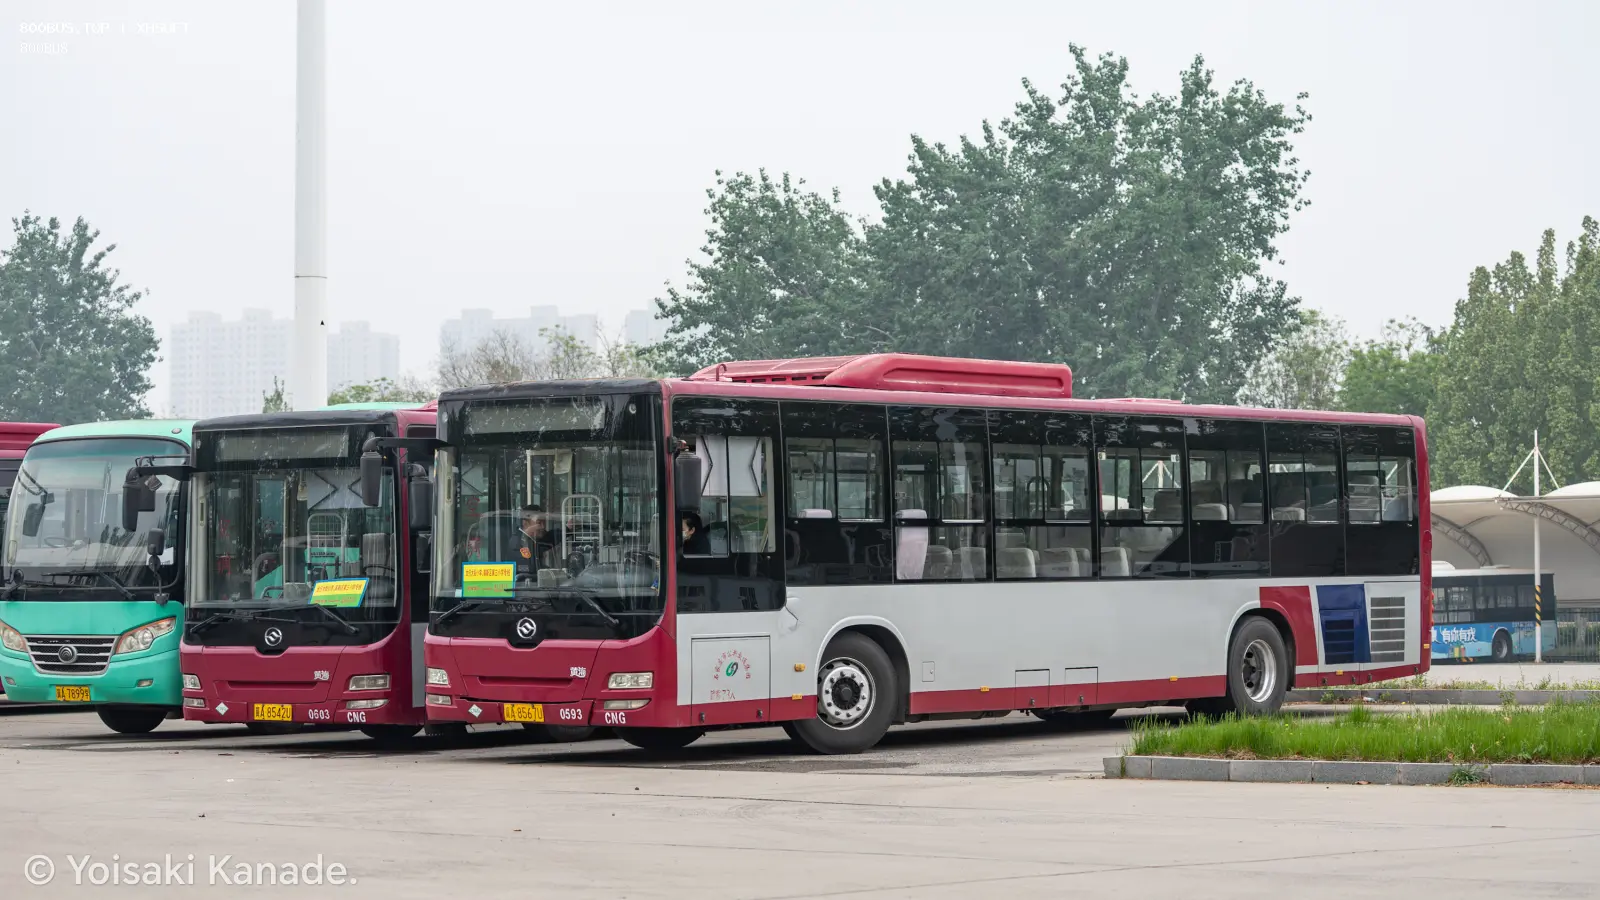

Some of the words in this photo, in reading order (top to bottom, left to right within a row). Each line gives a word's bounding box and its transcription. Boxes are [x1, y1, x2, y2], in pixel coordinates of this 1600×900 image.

[308, 708, 331, 720] 0603
[347, 711, 367, 723] CNG
[559, 708, 583, 720] 0593
[604, 711, 627, 724] CNG
